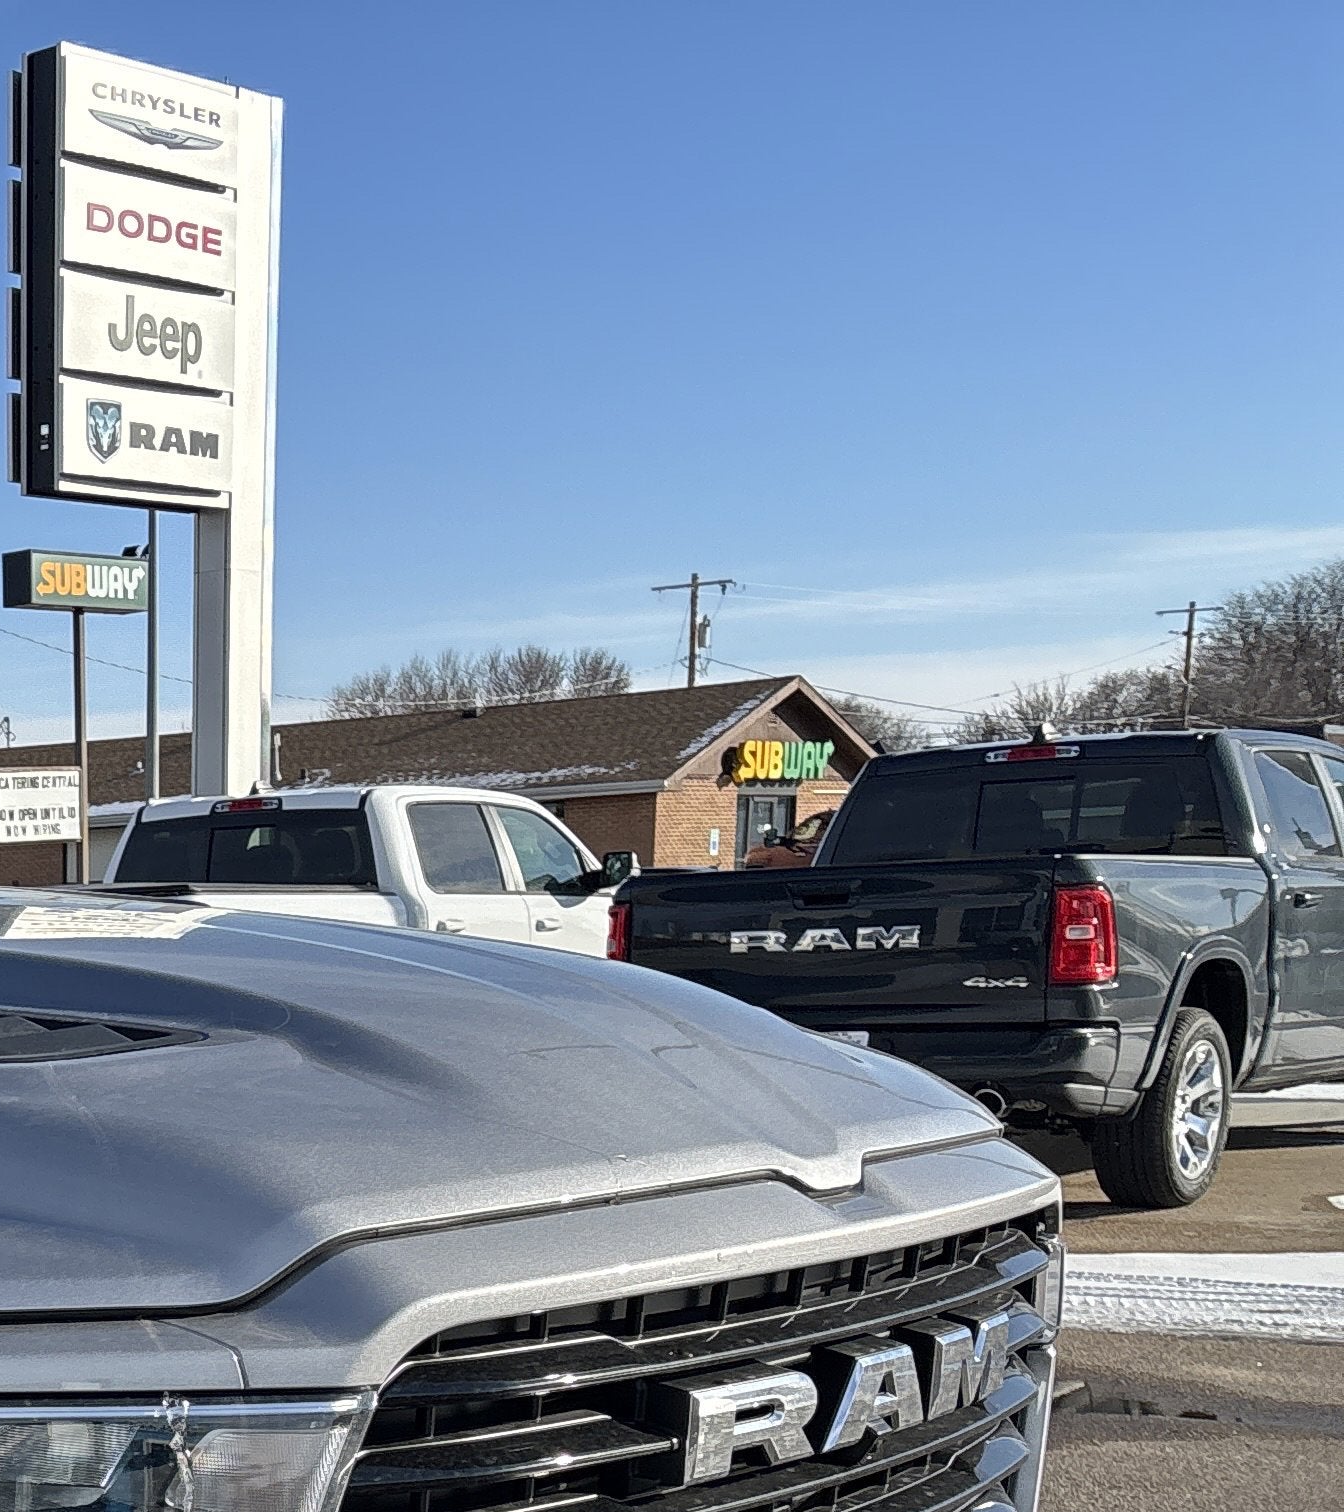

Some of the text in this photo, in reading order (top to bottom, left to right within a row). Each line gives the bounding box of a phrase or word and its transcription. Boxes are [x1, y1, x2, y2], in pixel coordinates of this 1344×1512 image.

[91, 82, 222, 128] CHRYSLER
[86, 202, 223, 257] DODGE
[108, 295, 202, 374] Jeep
[129, 421, 219, 459] RAM
[36, 561, 146, 600] SUBWAY
[738, 740, 835, 781] SUBWAY
[730, 925, 920, 953] RAM
[683, 1312, 1010, 1487] RAM
